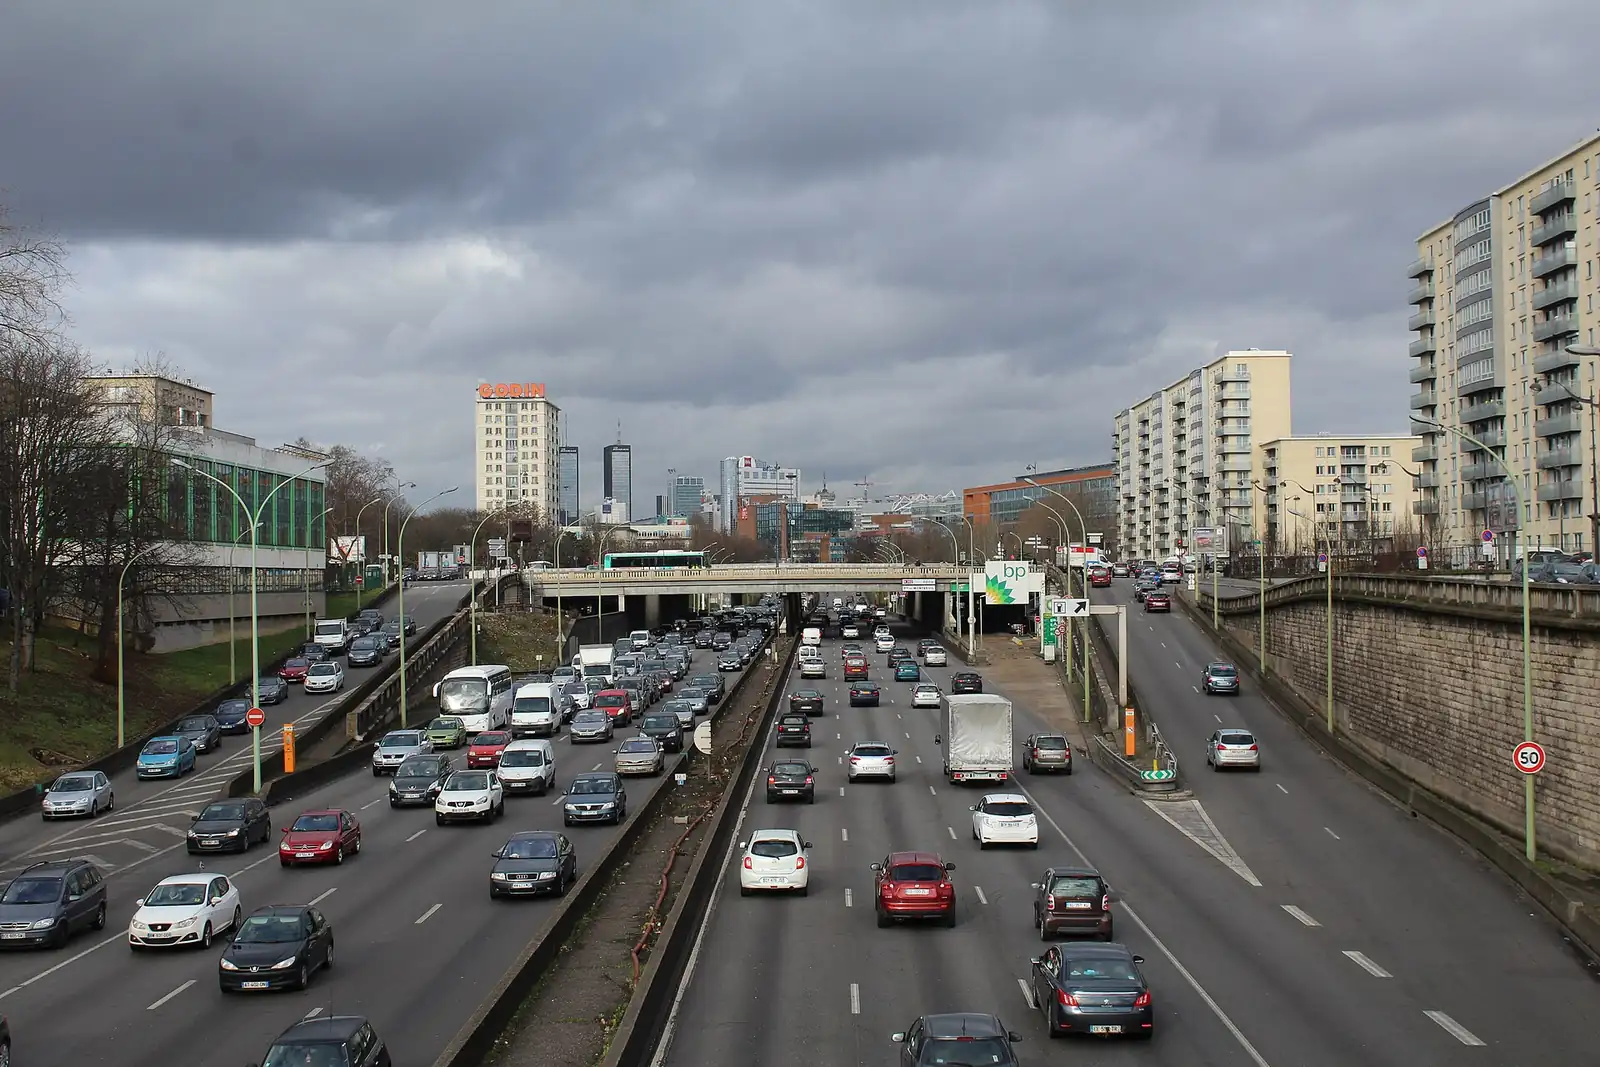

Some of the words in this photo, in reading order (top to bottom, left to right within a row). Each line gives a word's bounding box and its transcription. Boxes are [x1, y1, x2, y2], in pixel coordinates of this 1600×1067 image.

[479, 383, 545, 397] GODIN
[1003, 563, 1026, 581] bp
[1520, 751, 1539, 764] 50
